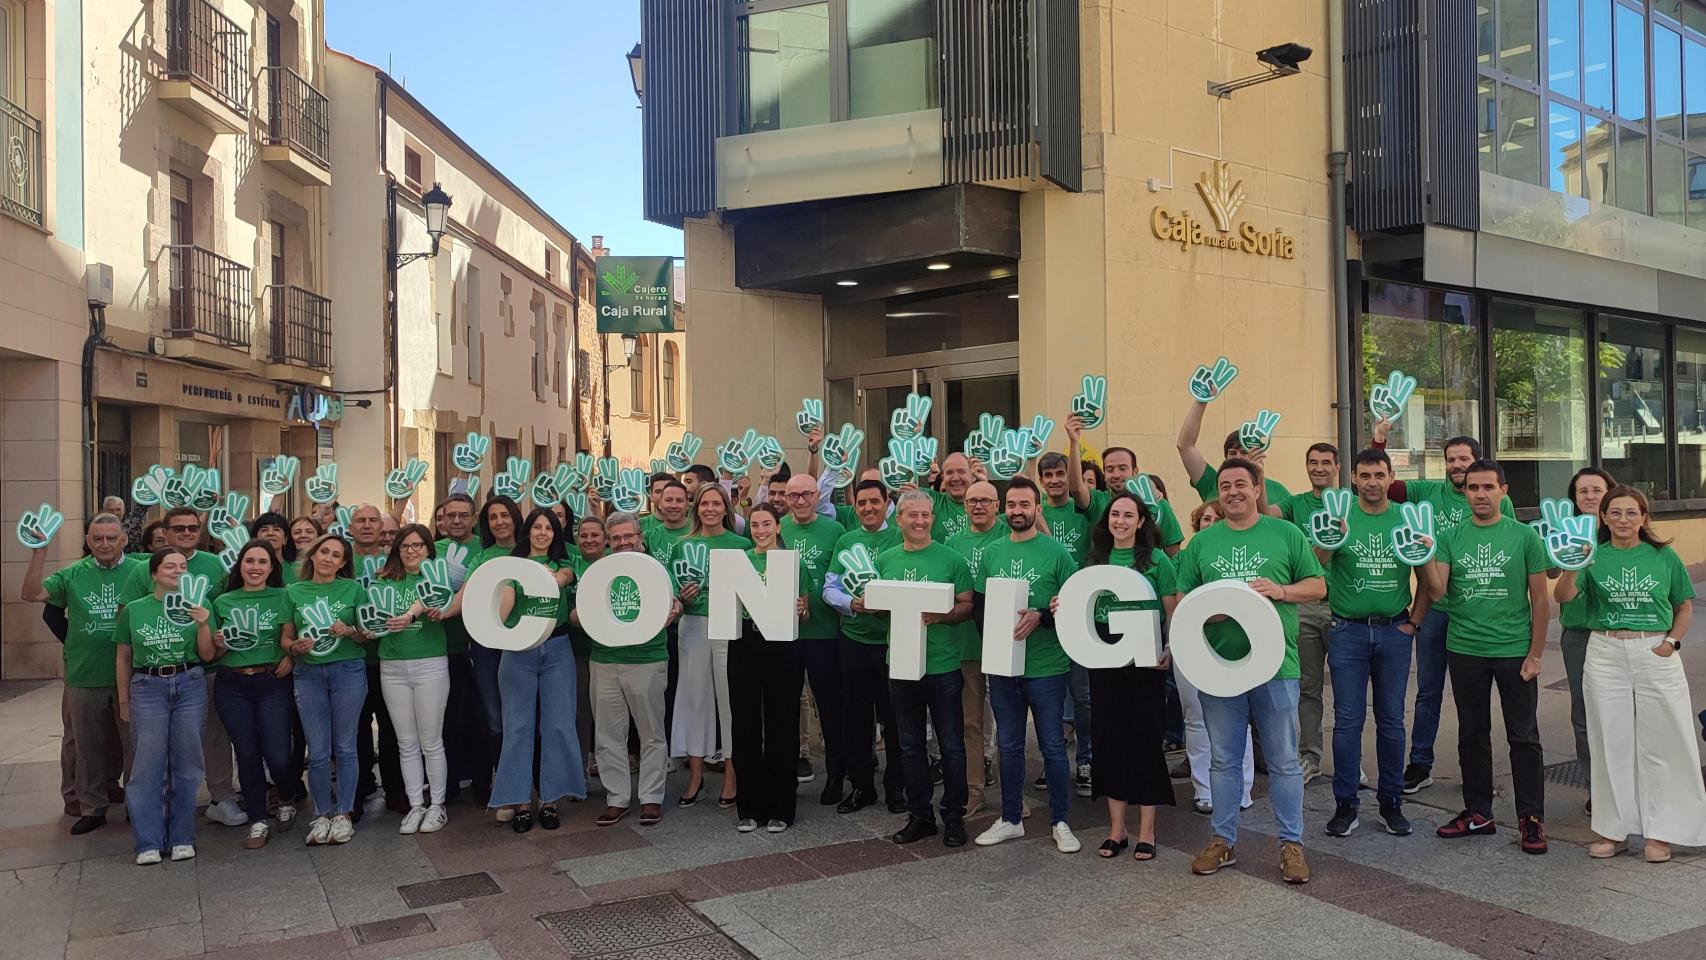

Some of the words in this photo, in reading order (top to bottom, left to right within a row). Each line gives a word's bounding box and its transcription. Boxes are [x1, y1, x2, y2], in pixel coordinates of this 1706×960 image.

[1151, 205, 1204, 252] Caja
[1208, 235, 1228, 248] rural
[1229, 237, 1241, 250] de
[1240, 219, 1296, 259] Soria
[634, 284, 667, 295] Cajero
[601, 305, 629, 319] Caja
[633, 305, 667, 316] Rural
[247, 394, 280, 409] ESTÉTICA
